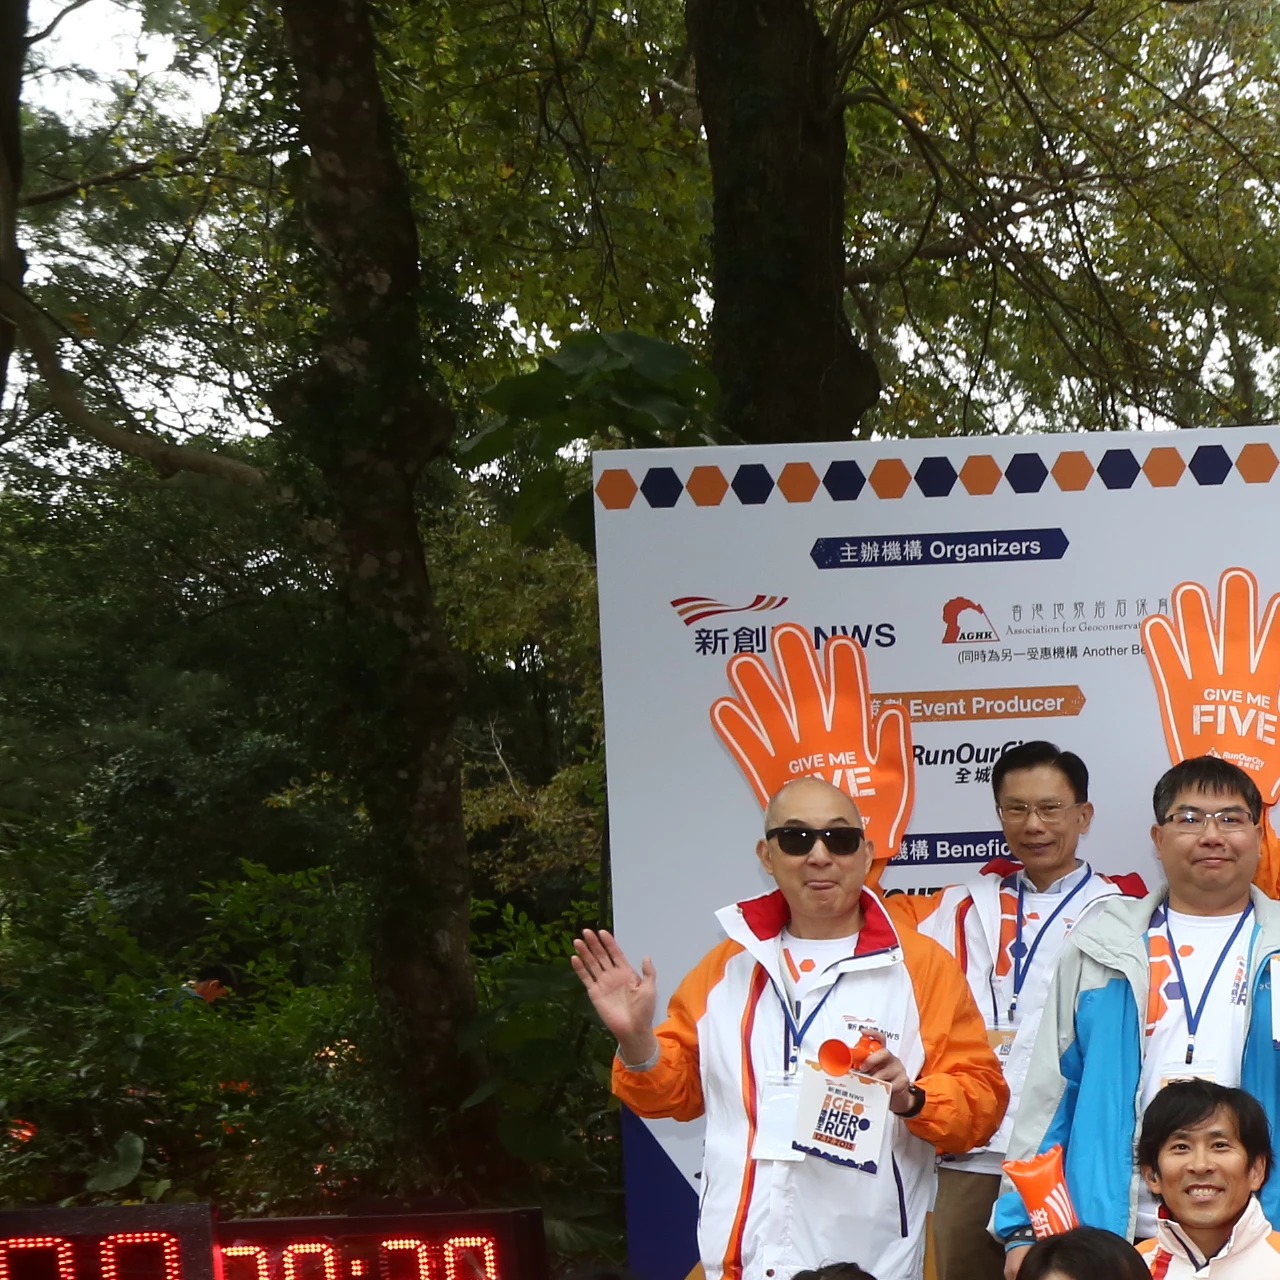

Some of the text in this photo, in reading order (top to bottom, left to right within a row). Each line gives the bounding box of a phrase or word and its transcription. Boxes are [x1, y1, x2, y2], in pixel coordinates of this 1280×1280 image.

[840, 537, 1042, 563] 主辦機構 Organizers
[958, 631, 993, 641] AGHK
[1005, 623, 1060, 636] Association
[1063, 622, 1076, 633] for
[695, 625, 775, 656] 新創
[1082, 644, 1127, 657] Another
[909, 694, 1064, 717] Event Producer
[1203, 688, 1271, 709] GIVE ME
[1192, 704, 1278, 746] FIVE
[788, 751, 857, 774] GIVE ME
[1223, 751, 1265, 767] RunOurCity
[849, 1092, 865, 1102] NWS
[814, 1133, 854, 1150] 12.12.2015
[824, 1121, 857, 1142] RUN
